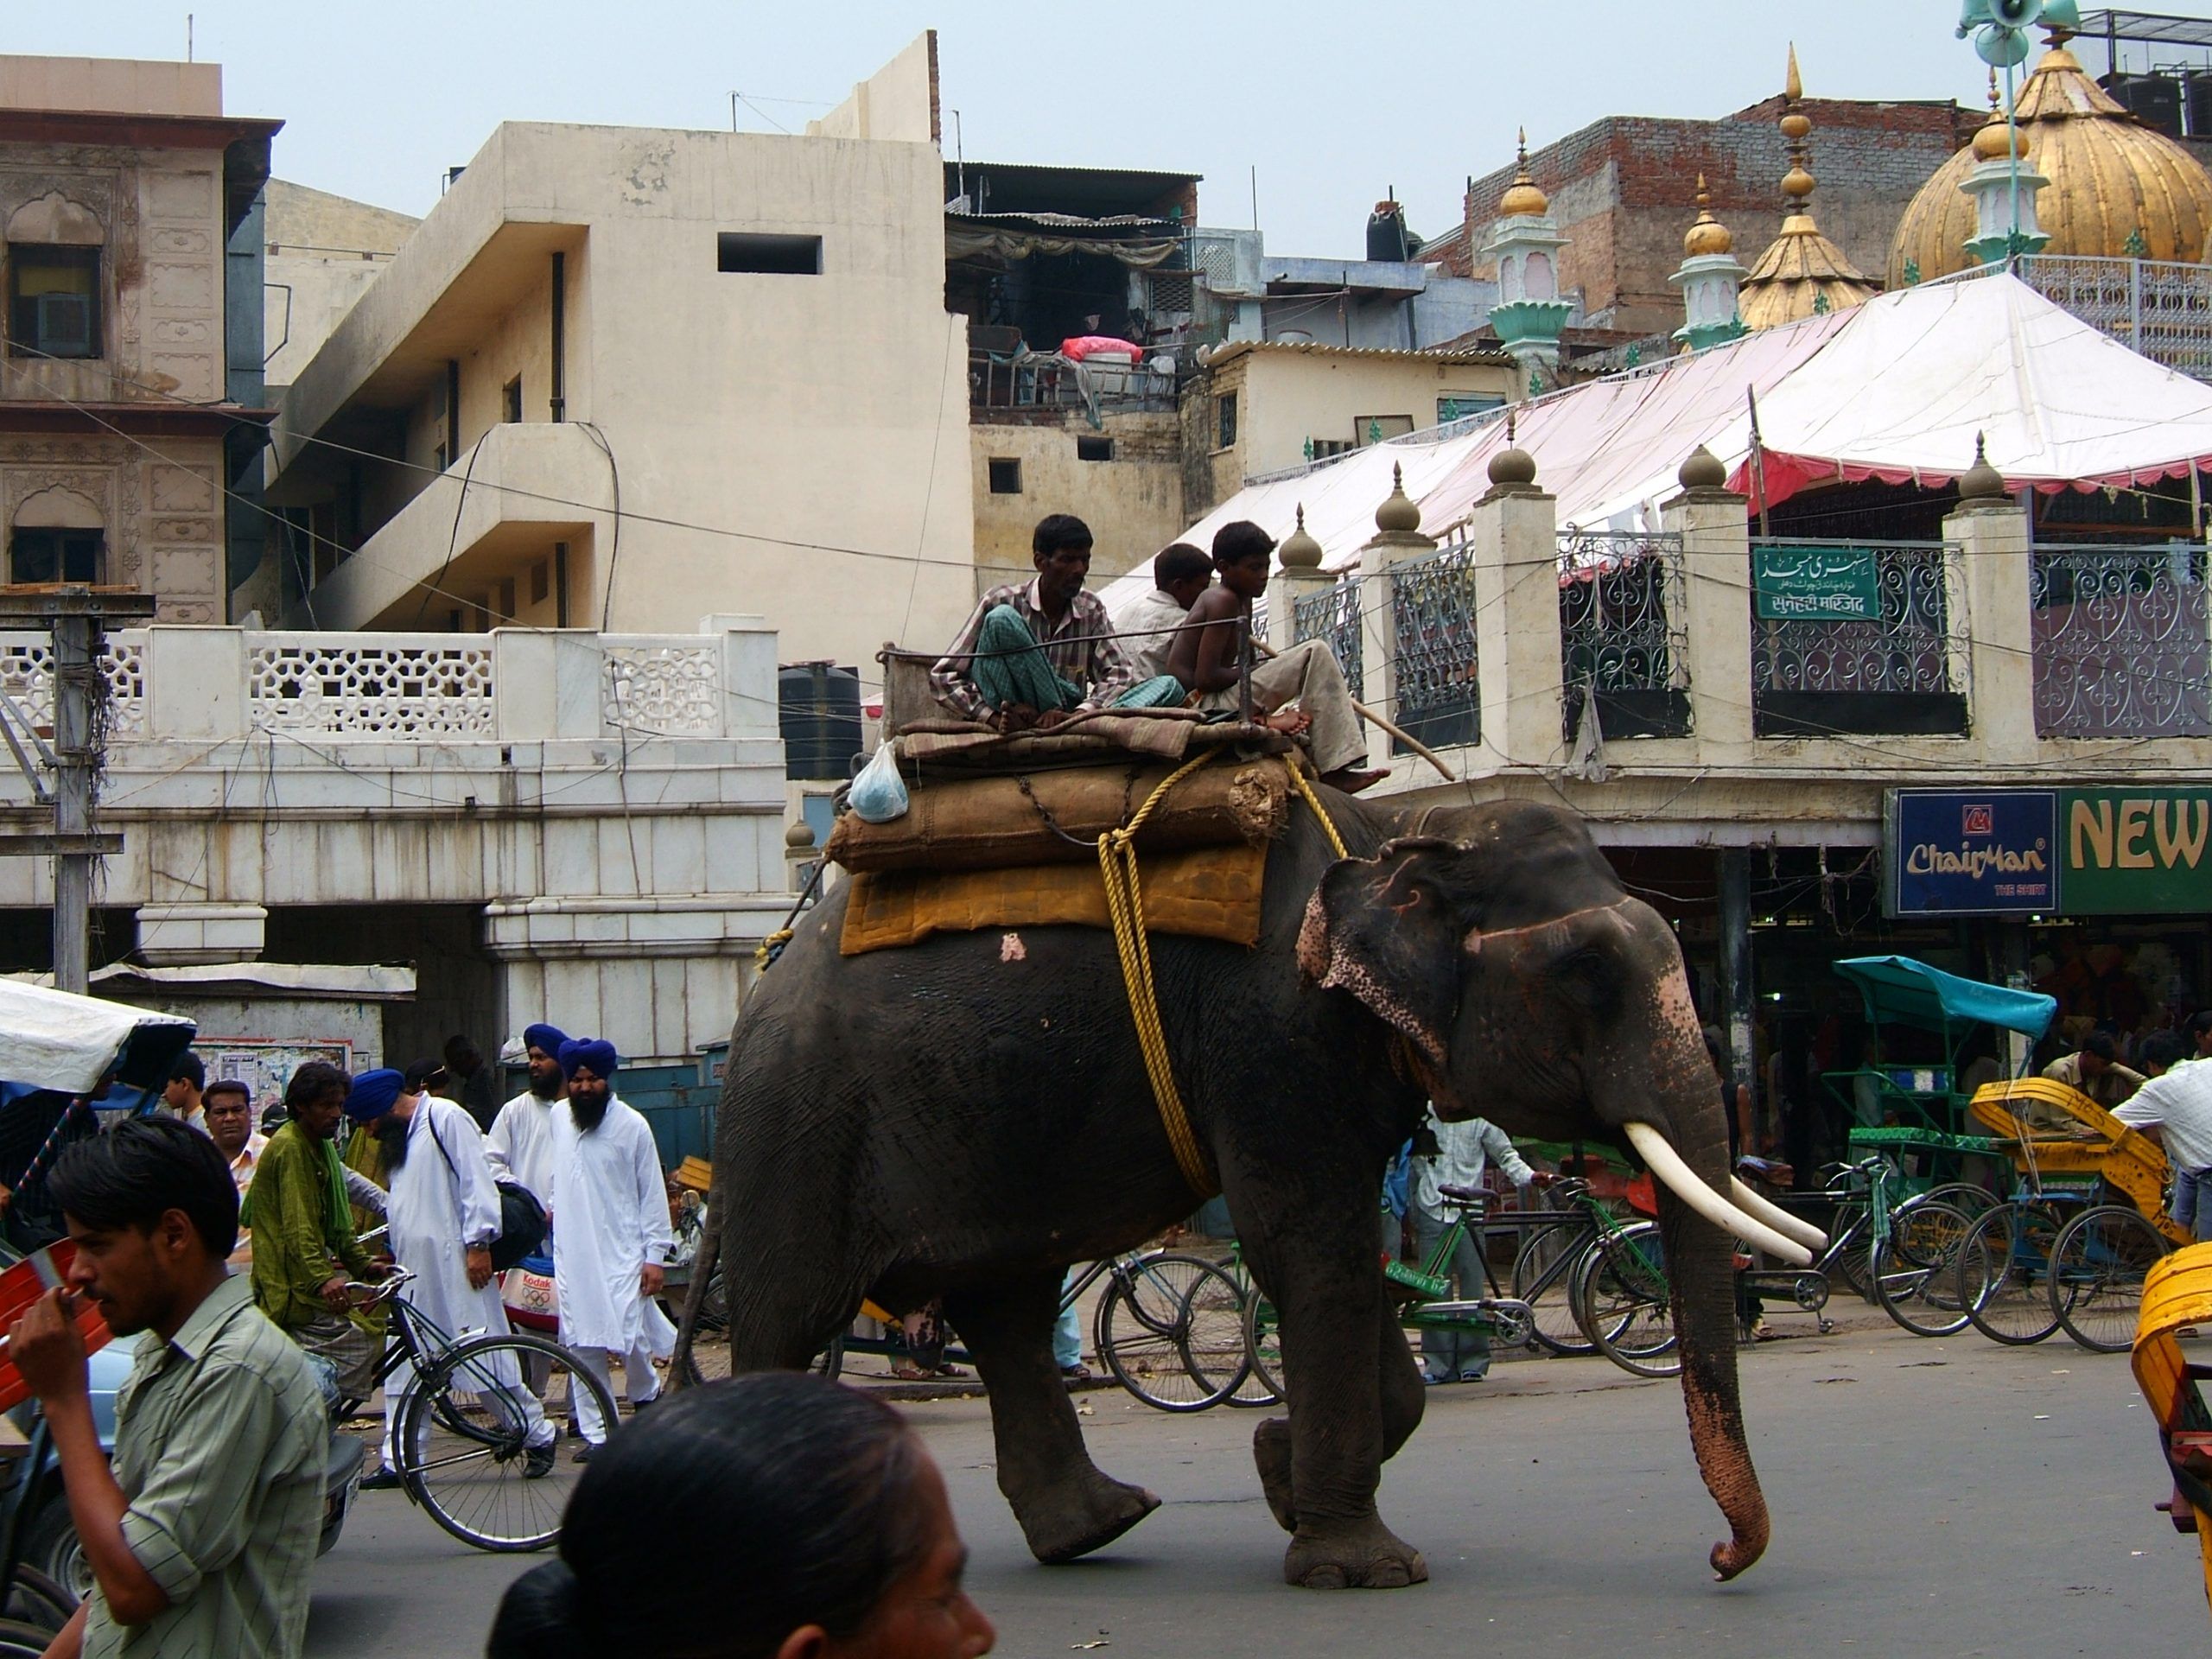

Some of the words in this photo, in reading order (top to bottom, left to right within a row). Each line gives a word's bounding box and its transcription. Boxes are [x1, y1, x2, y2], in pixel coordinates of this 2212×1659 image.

[2070, 799, 2209, 869] NEW
[1994, 884, 2015, 896] THE
[2017, 883, 2046, 896] SHIRT
[524, 1273, 551, 1288] Kodak
